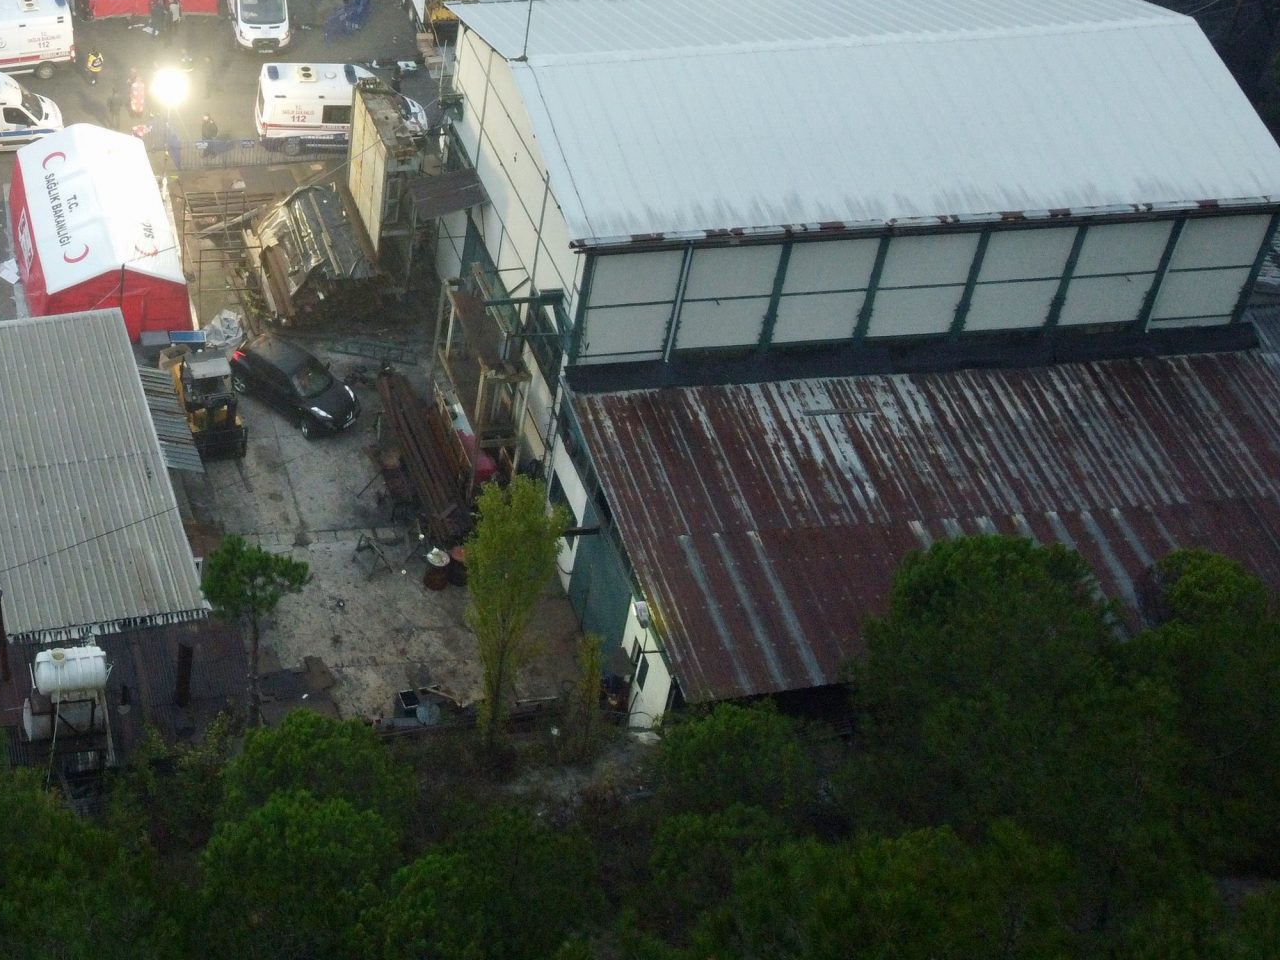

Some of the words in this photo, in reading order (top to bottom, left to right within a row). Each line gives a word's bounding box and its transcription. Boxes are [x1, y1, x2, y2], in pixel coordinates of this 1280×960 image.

[38, 41, 50, 49] 112
[290, 115, 307, 123] 112
[44, 172, 61, 204] SAĞLIK
[66, 194, 79, 213] T.C.
[51, 203, 71, 248] BAKANLIĞI
